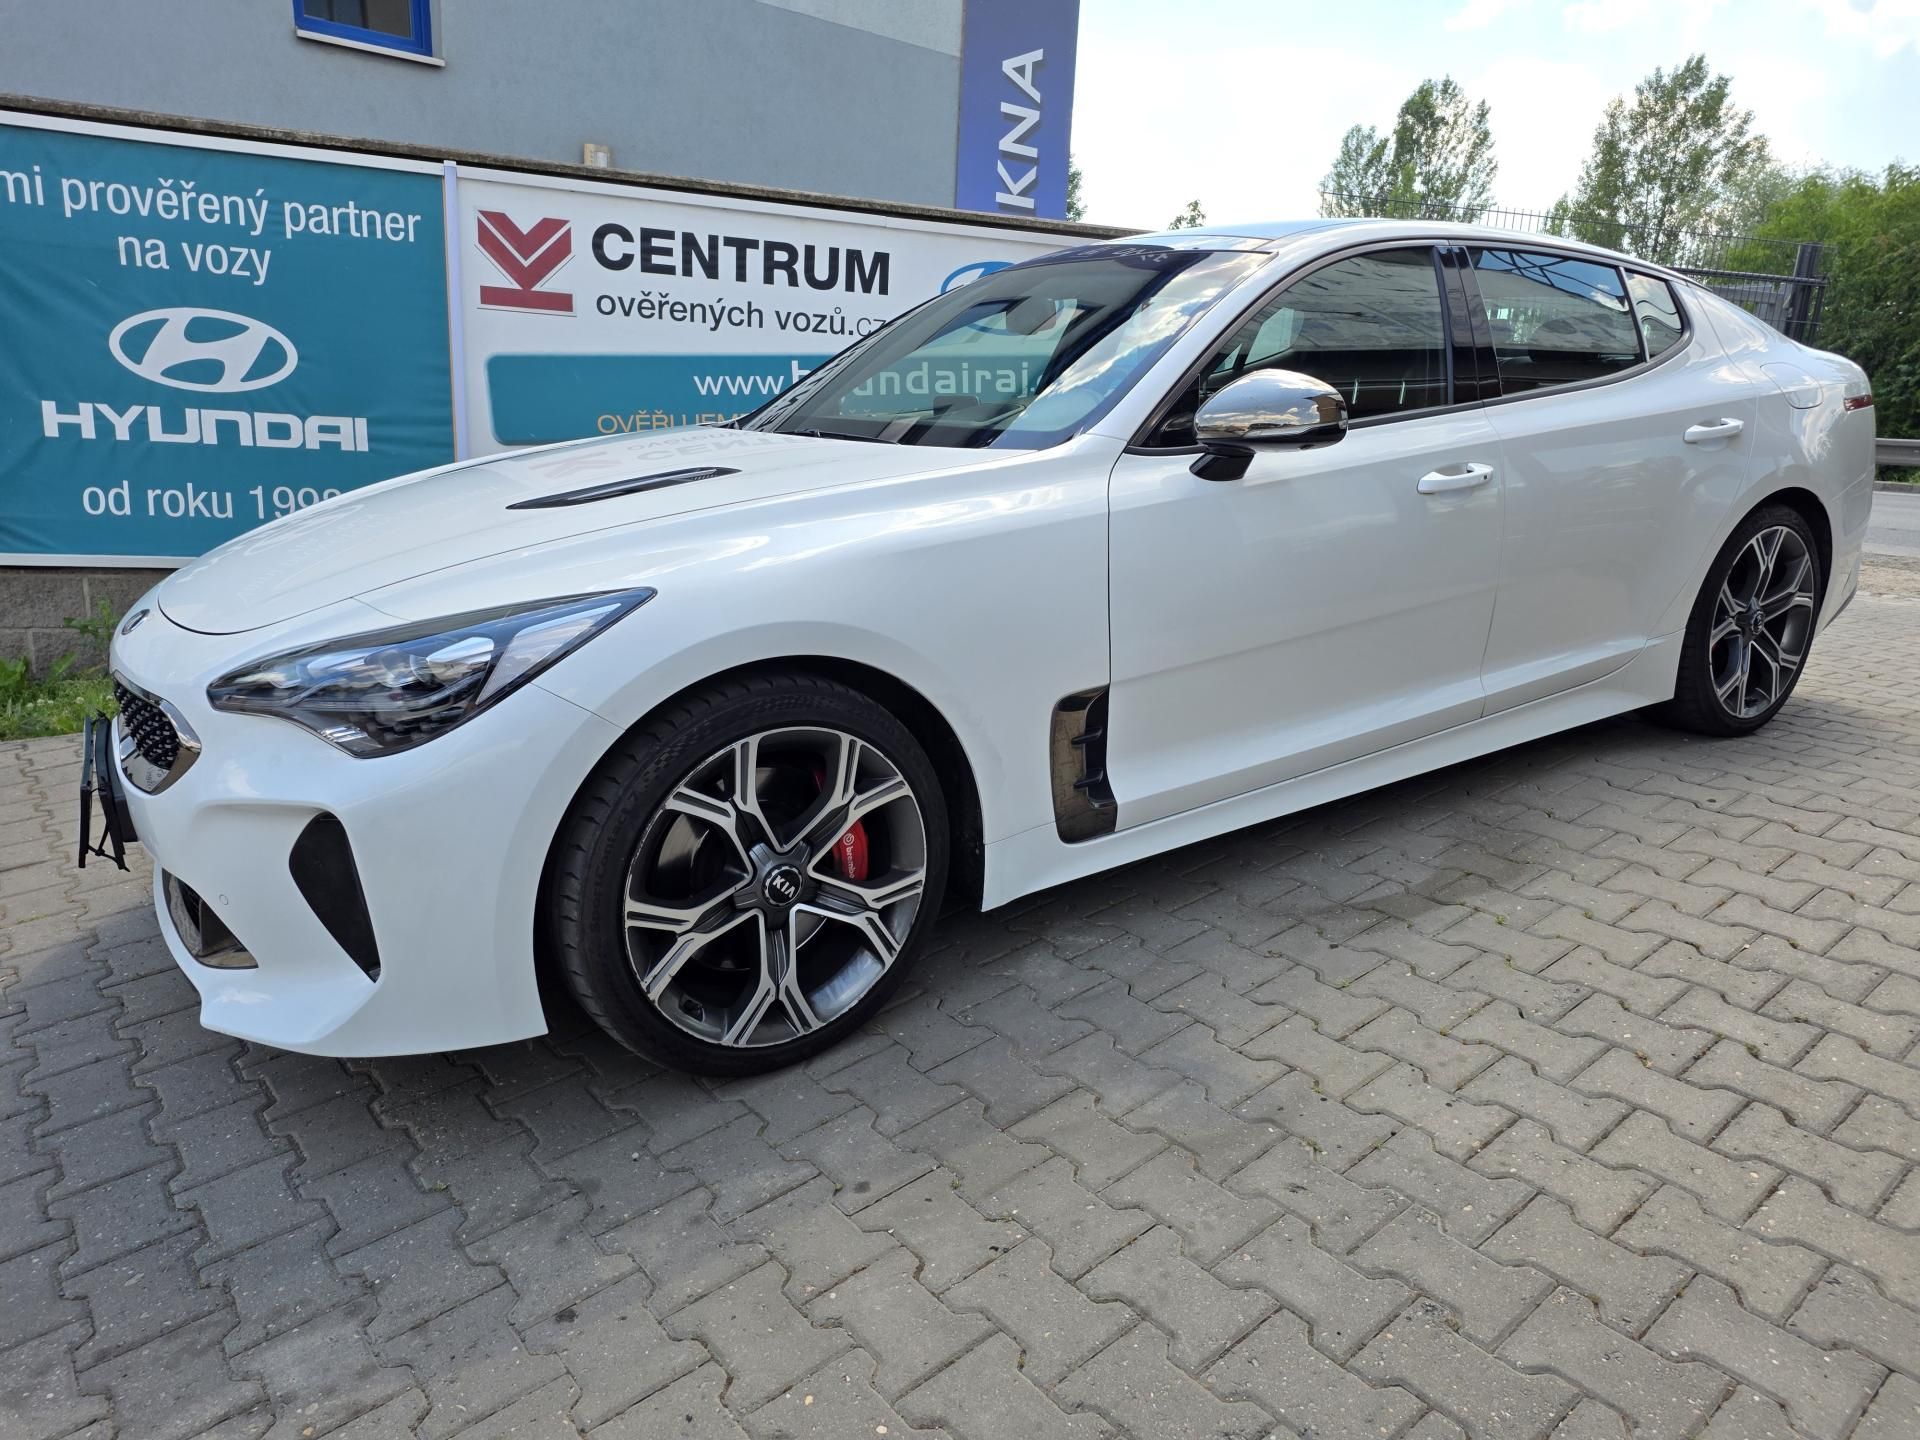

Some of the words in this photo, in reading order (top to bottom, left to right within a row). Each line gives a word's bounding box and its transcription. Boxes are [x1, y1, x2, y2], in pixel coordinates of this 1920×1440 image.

[996, 48, 1044, 209] KNA
[61, 177, 269, 236] prověřený
[284, 200, 421, 243] partner
[118, 235, 169, 270] na
[182, 241, 272, 286] vozy
[591, 222, 890, 296] CENTRUM
[595, 290, 764, 332] ověřených
[41, 399, 369, 453] HYUNDAI
[82, 479, 132, 516] od
[147, 482, 234, 519] roku
[772, 875, 796, 899] KIA
[845, 845, 855, 879] brembo
